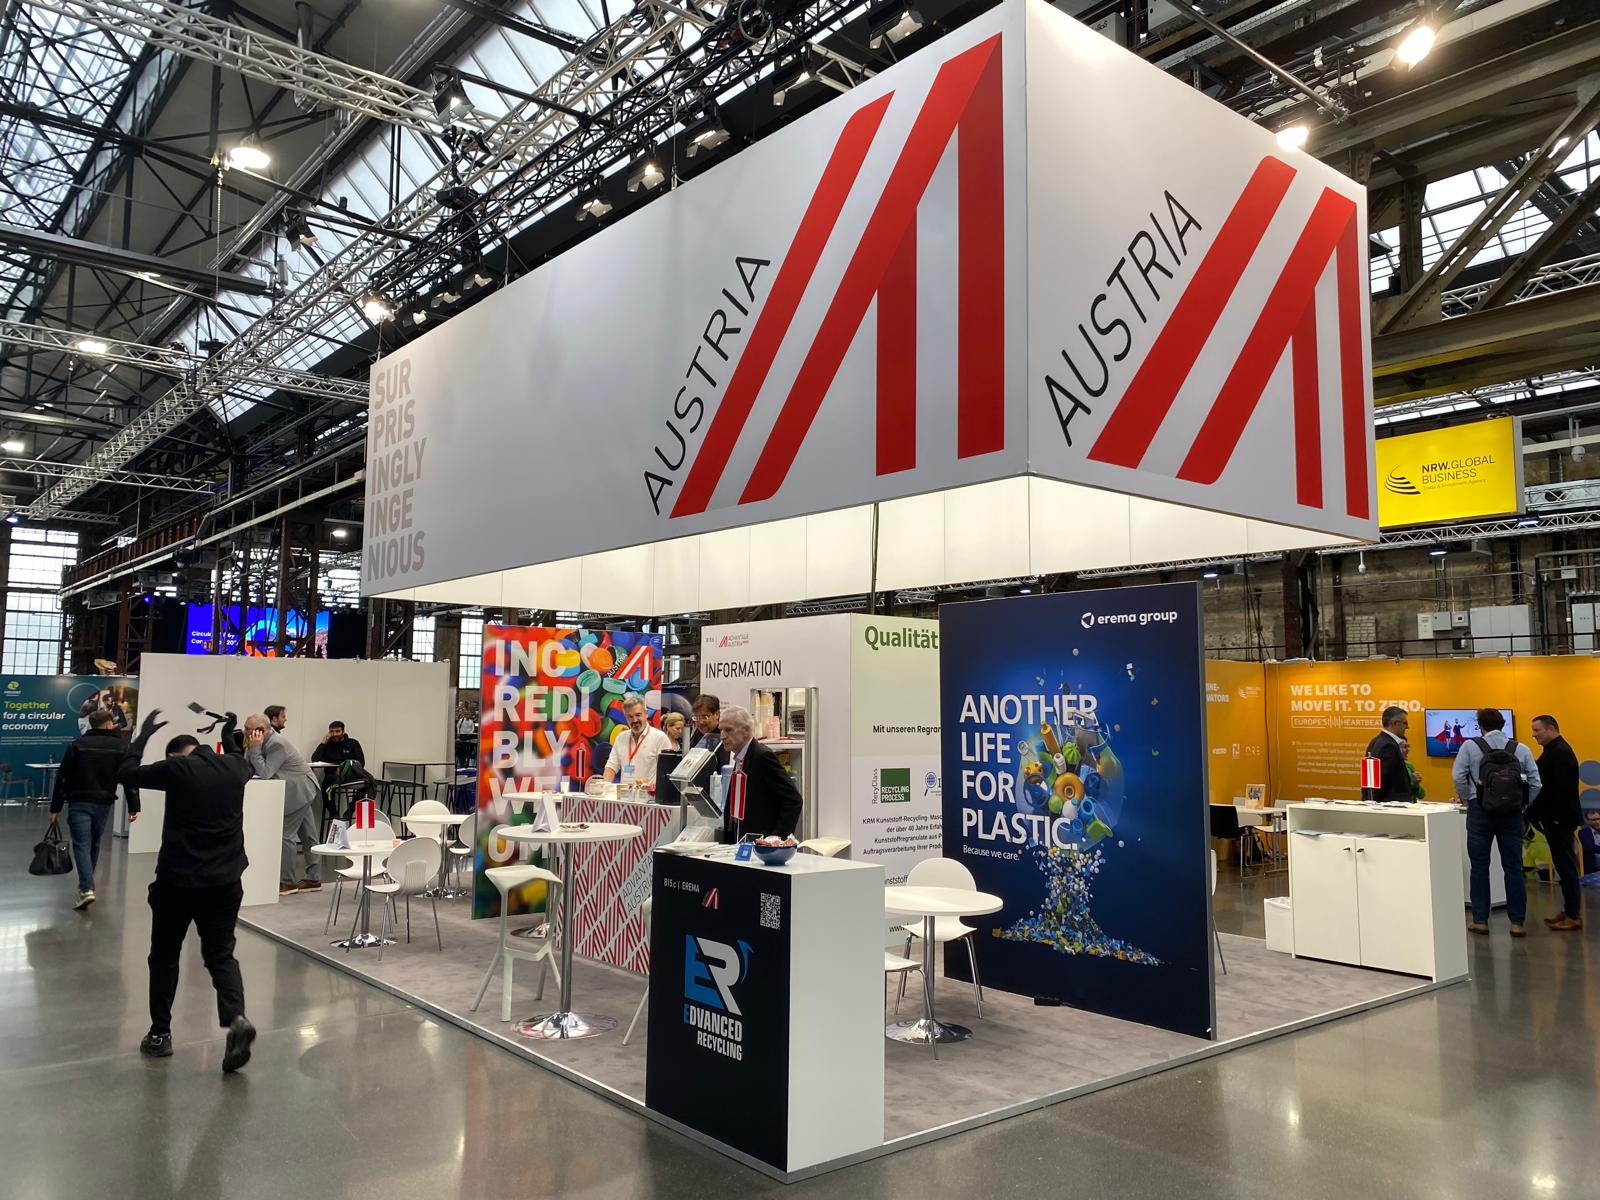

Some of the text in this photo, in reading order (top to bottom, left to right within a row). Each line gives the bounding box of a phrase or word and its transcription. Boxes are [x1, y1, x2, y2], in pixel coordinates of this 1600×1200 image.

[1045, 190, 1202, 447] AUSTRIA
[374, 359, 411, 410] SUR
[644, 257, 771, 516] AUSTRIA
[373, 399, 415, 453] PRIS
[371, 438, 427, 496] INGLY
[1422, 468, 1477, 484] BUSINESS
[369, 488, 414, 538] INGE
[367, 531, 426, 581] NIOUS
[1097, 611, 1178, 625] erema group
[864, 625, 939, 651] Qualität
[494, 639, 568, 678] INC
[705, 660, 782, 679] INFORMATION
[493, 686, 590, 722] REDI
[1290, 683, 1372, 696] WE LIKE TO
[3, 712, 18, 720] for
[27, 711, 66, 720] circular
[4, 701, 50, 711] Together
[959, 694, 1100, 726] ANOTHER
[1291, 700, 1332, 712] MOVE
[1334, 700, 1352, 712] IT.
[1354, 700, 1376, 712] TO
[2, 723, 49, 732] economy
[873, 725, 885, 733] Mit
[492, 730, 571, 769] BLY
[961, 731, 1012, 763] LIFE
[881, 786, 909, 794] RECYCLING
[962, 770, 1016, 804] FOR
[962, 807, 1078, 851] PLASTIC.
[962, 844, 1020, 860] Because we care.
[681, 881, 700, 893] EREMA
[684, 1003, 743, 1042] EDVANCED
[697, 1030, 743, 1061] RECYCLING
